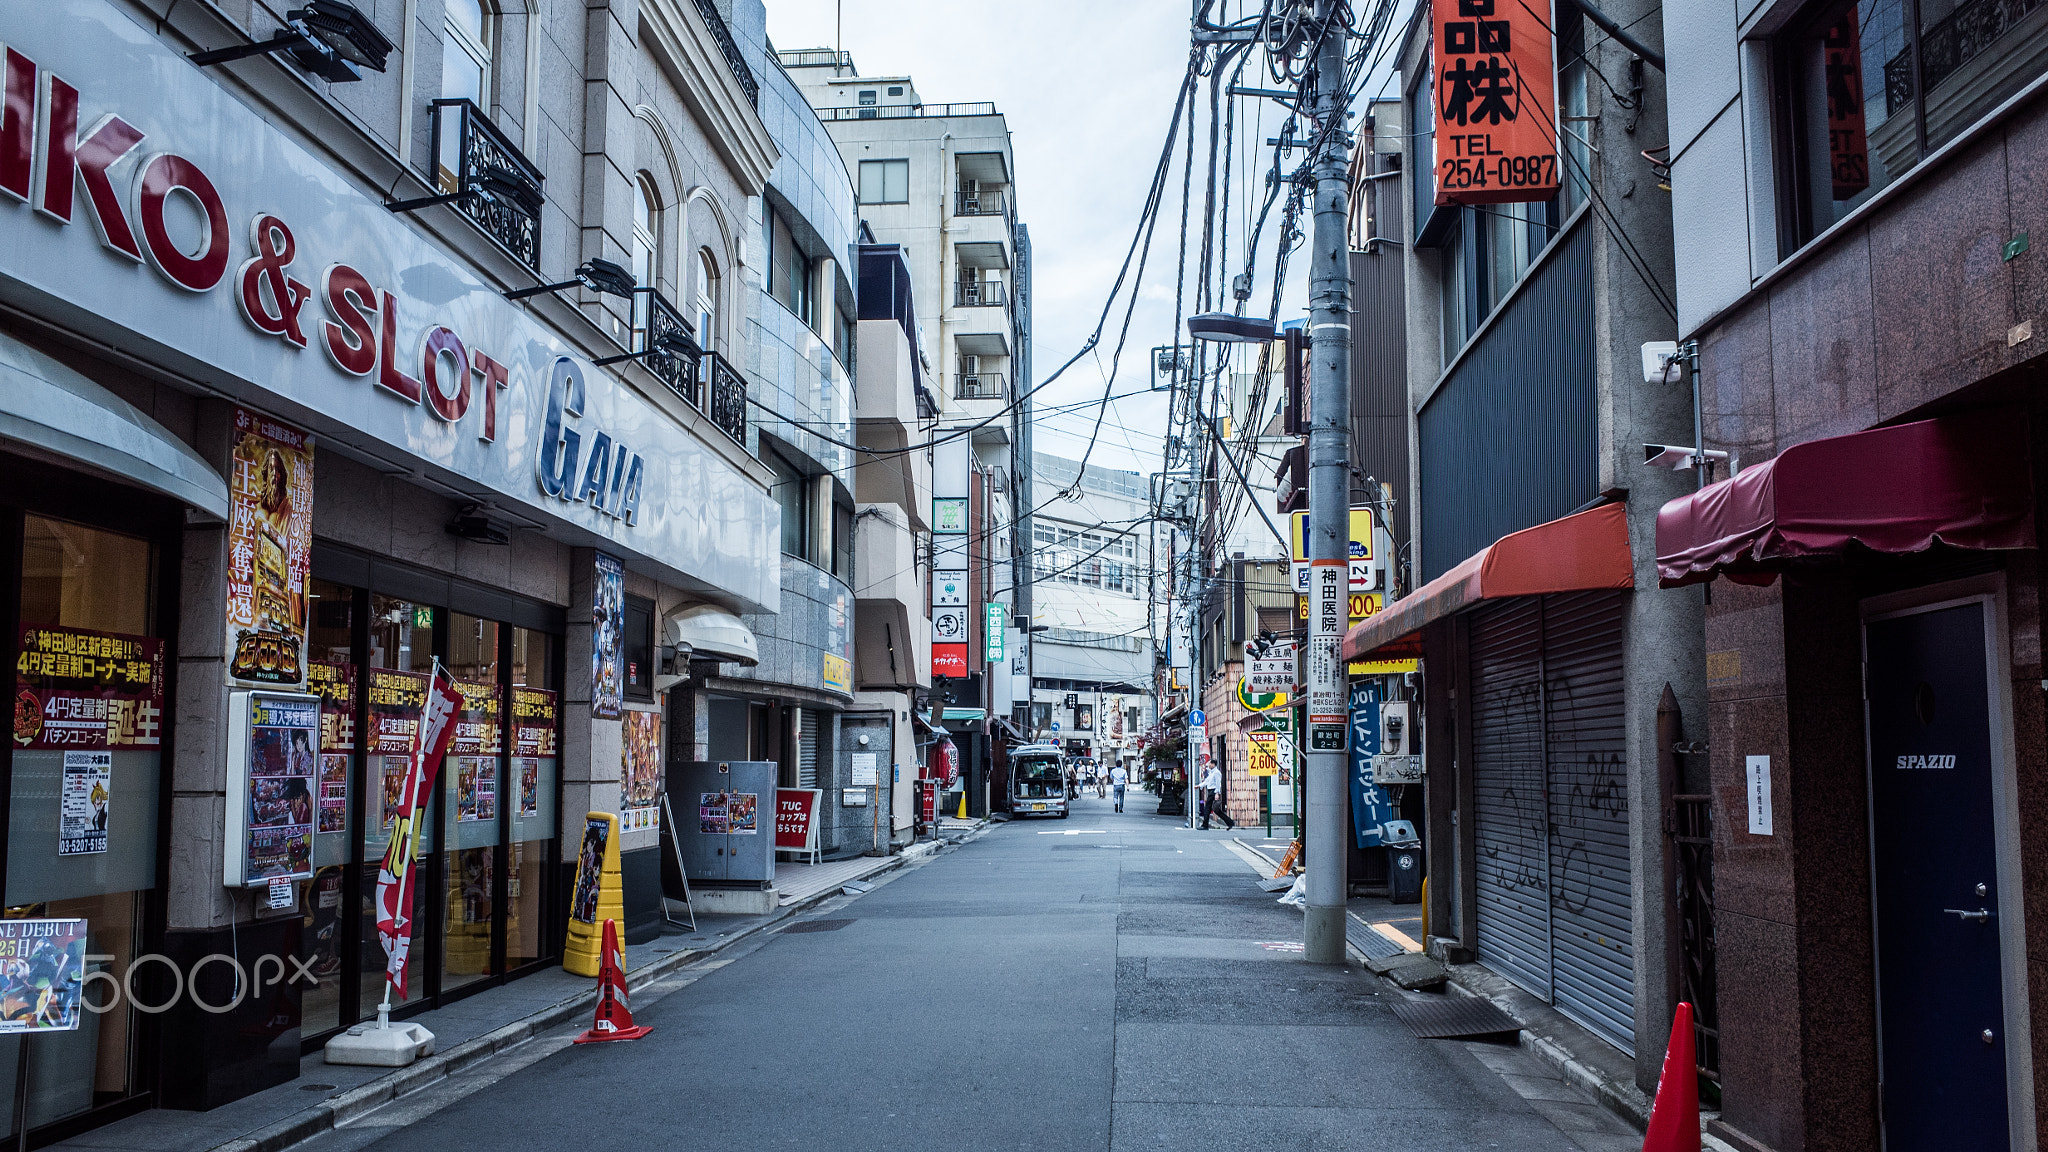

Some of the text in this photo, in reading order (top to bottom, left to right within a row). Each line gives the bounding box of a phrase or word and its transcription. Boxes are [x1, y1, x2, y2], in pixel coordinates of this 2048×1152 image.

[1450, 134, 1503, 157] TEL
[1442, 155, 1556, 188] 254-0987
[235, 212, 311, 348] &
[318, 262, 509, 443] SLOT
[535, 354, 645, 527] GAIA
[288, 456, 307, 596] 神再び降臨
[227, 456, 258, 626] 王座奪還
[1321, 568, 1337, 632] 神田医院
[38, 629, 132, 660] 神田地区新登場!!
[1261, 648, 1292, 658] 婆豆腐
[17, 651, 151, 684] 4円定量制コーナー実施
[307, 663, 336, 682] 新登場!!
[1253, 675, 1293, 685] 酸辣湯麺
[45, 696, 107, 719] 4円定量制
[368, 687, 428, 707] 円定量制コーナー実
[106, 699, 160, 746] 誕生
[252, 700, 316, 727] 5月導入予定機種
[44, 728, 106, 744] パチンココーナー
[321, 713, 354, 750] 誕生
[380, 718, 409, 734] 4円定量制
[1250, 754, 1277, 770] 2,600
[1896, 755, 1957, 769] SPAZIO
[781, 801, 802, 811] TUC
[60, 838, 107, 853] 03-5207-5155
[21, 922, 77, 937] DEBUT
